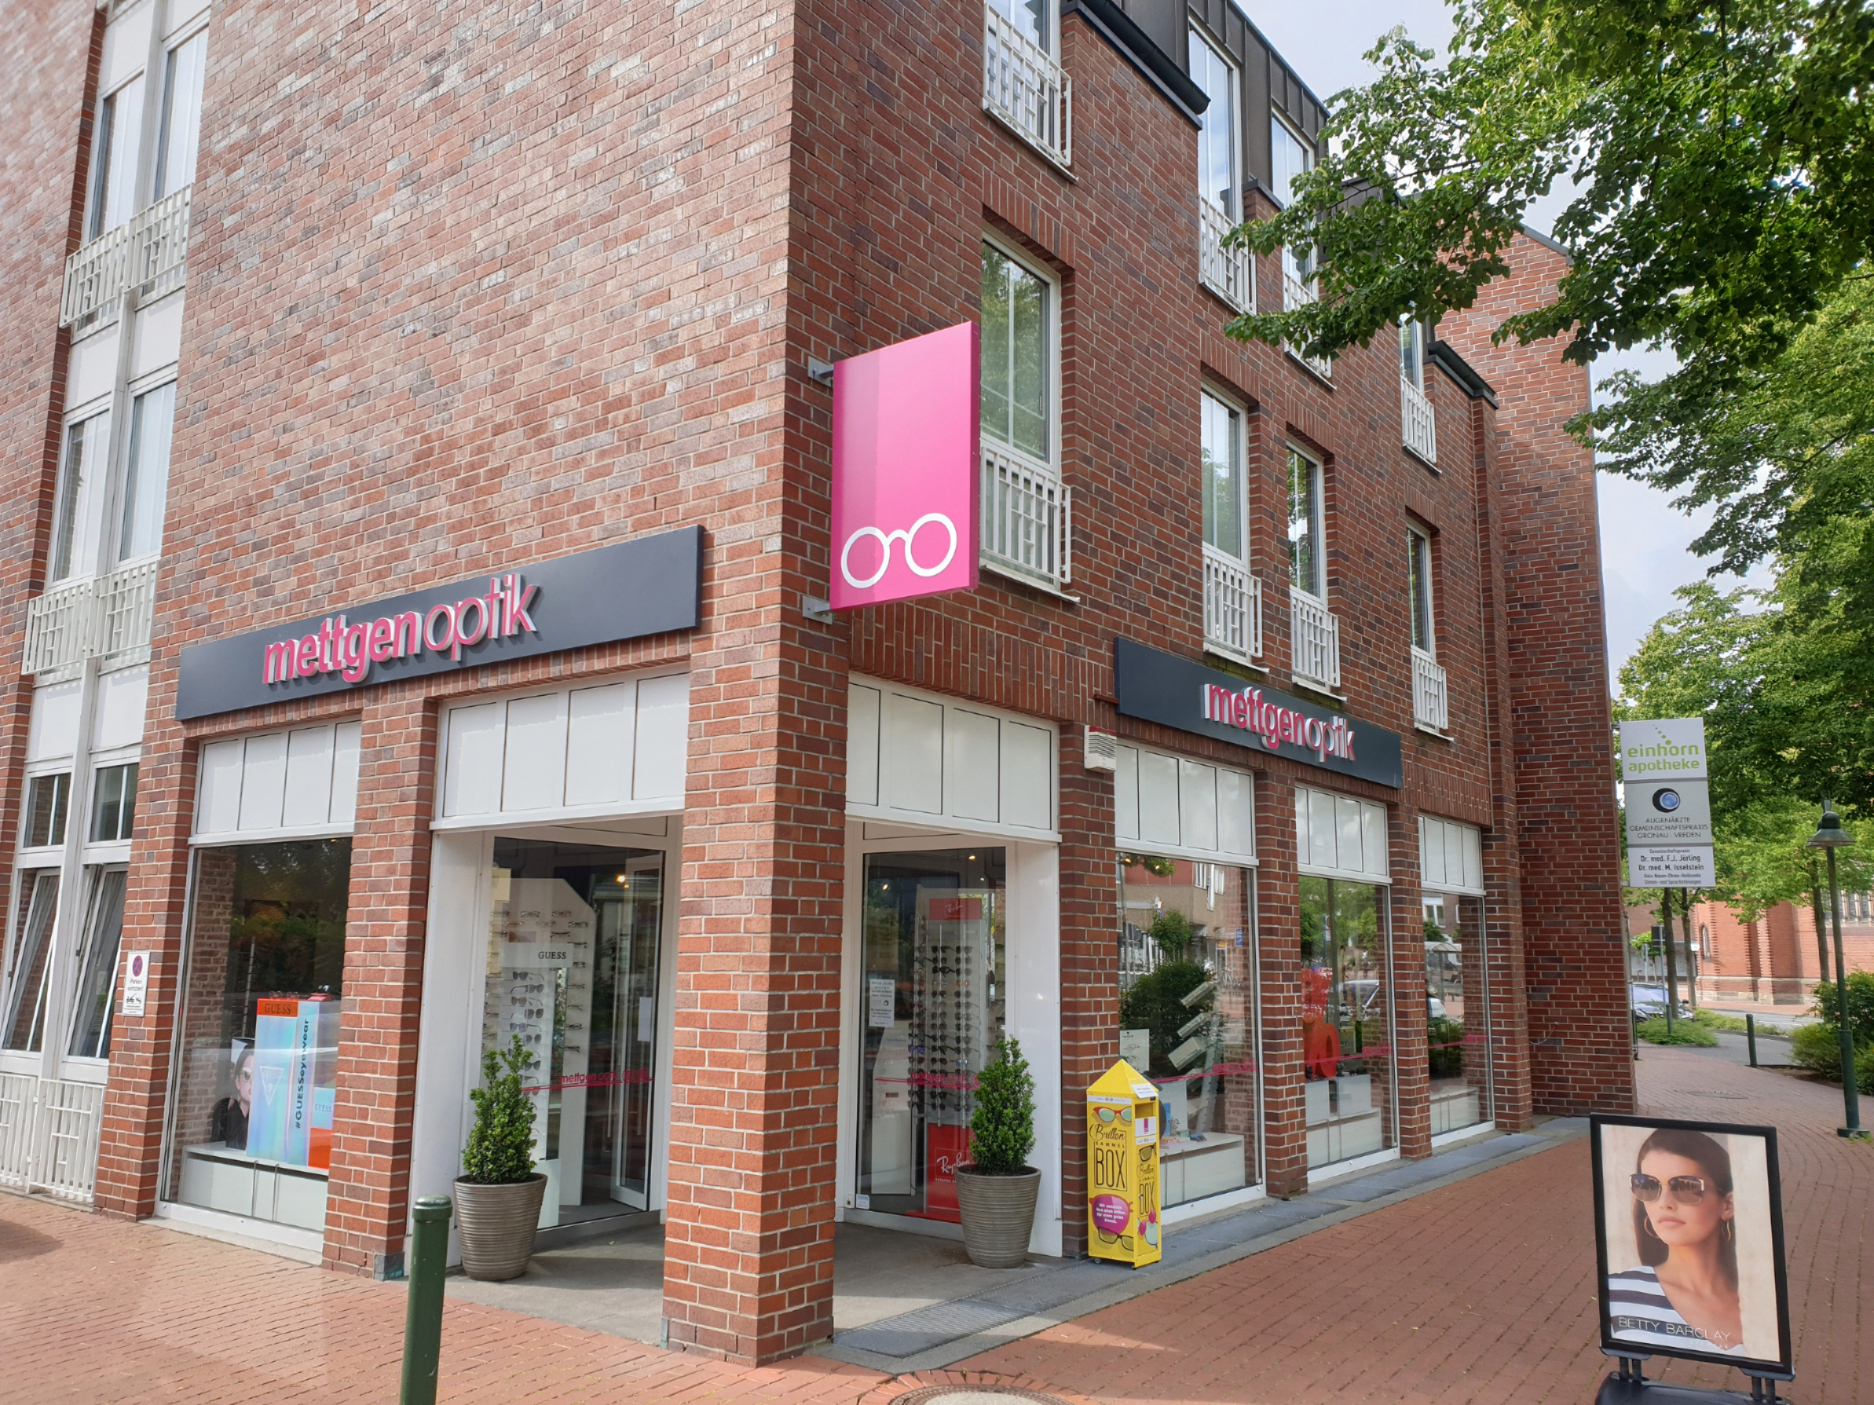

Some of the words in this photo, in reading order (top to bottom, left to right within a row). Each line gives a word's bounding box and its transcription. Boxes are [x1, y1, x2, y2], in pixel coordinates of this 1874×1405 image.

[1627, 742, 1699, 758] einhorn
[1628, 758, 1700, 774] apotheke
[1645, 815, 1691, 824] AUGENÄRZTE
[1629, 824, 1709, 832] GEMEINSCHAFTSPRAXIS
[1674, 863, 1705, 871] Isselstein
[538, 951, 567, 960] GUESS
[264, 1002, 291, 1015] GUESS
[295, 1019, 310, 1130] #GUESSeyewear
[1096, 1141, 1125, 1149] SAMMEL
[1095, 1147, 1126, 1189] BOX
[1139, 1181, 1155, 1216] BOX
[1618, 1316, 1660, 1332] BETTY
[1665, 1323, 1732, 1341] BARCLAY
